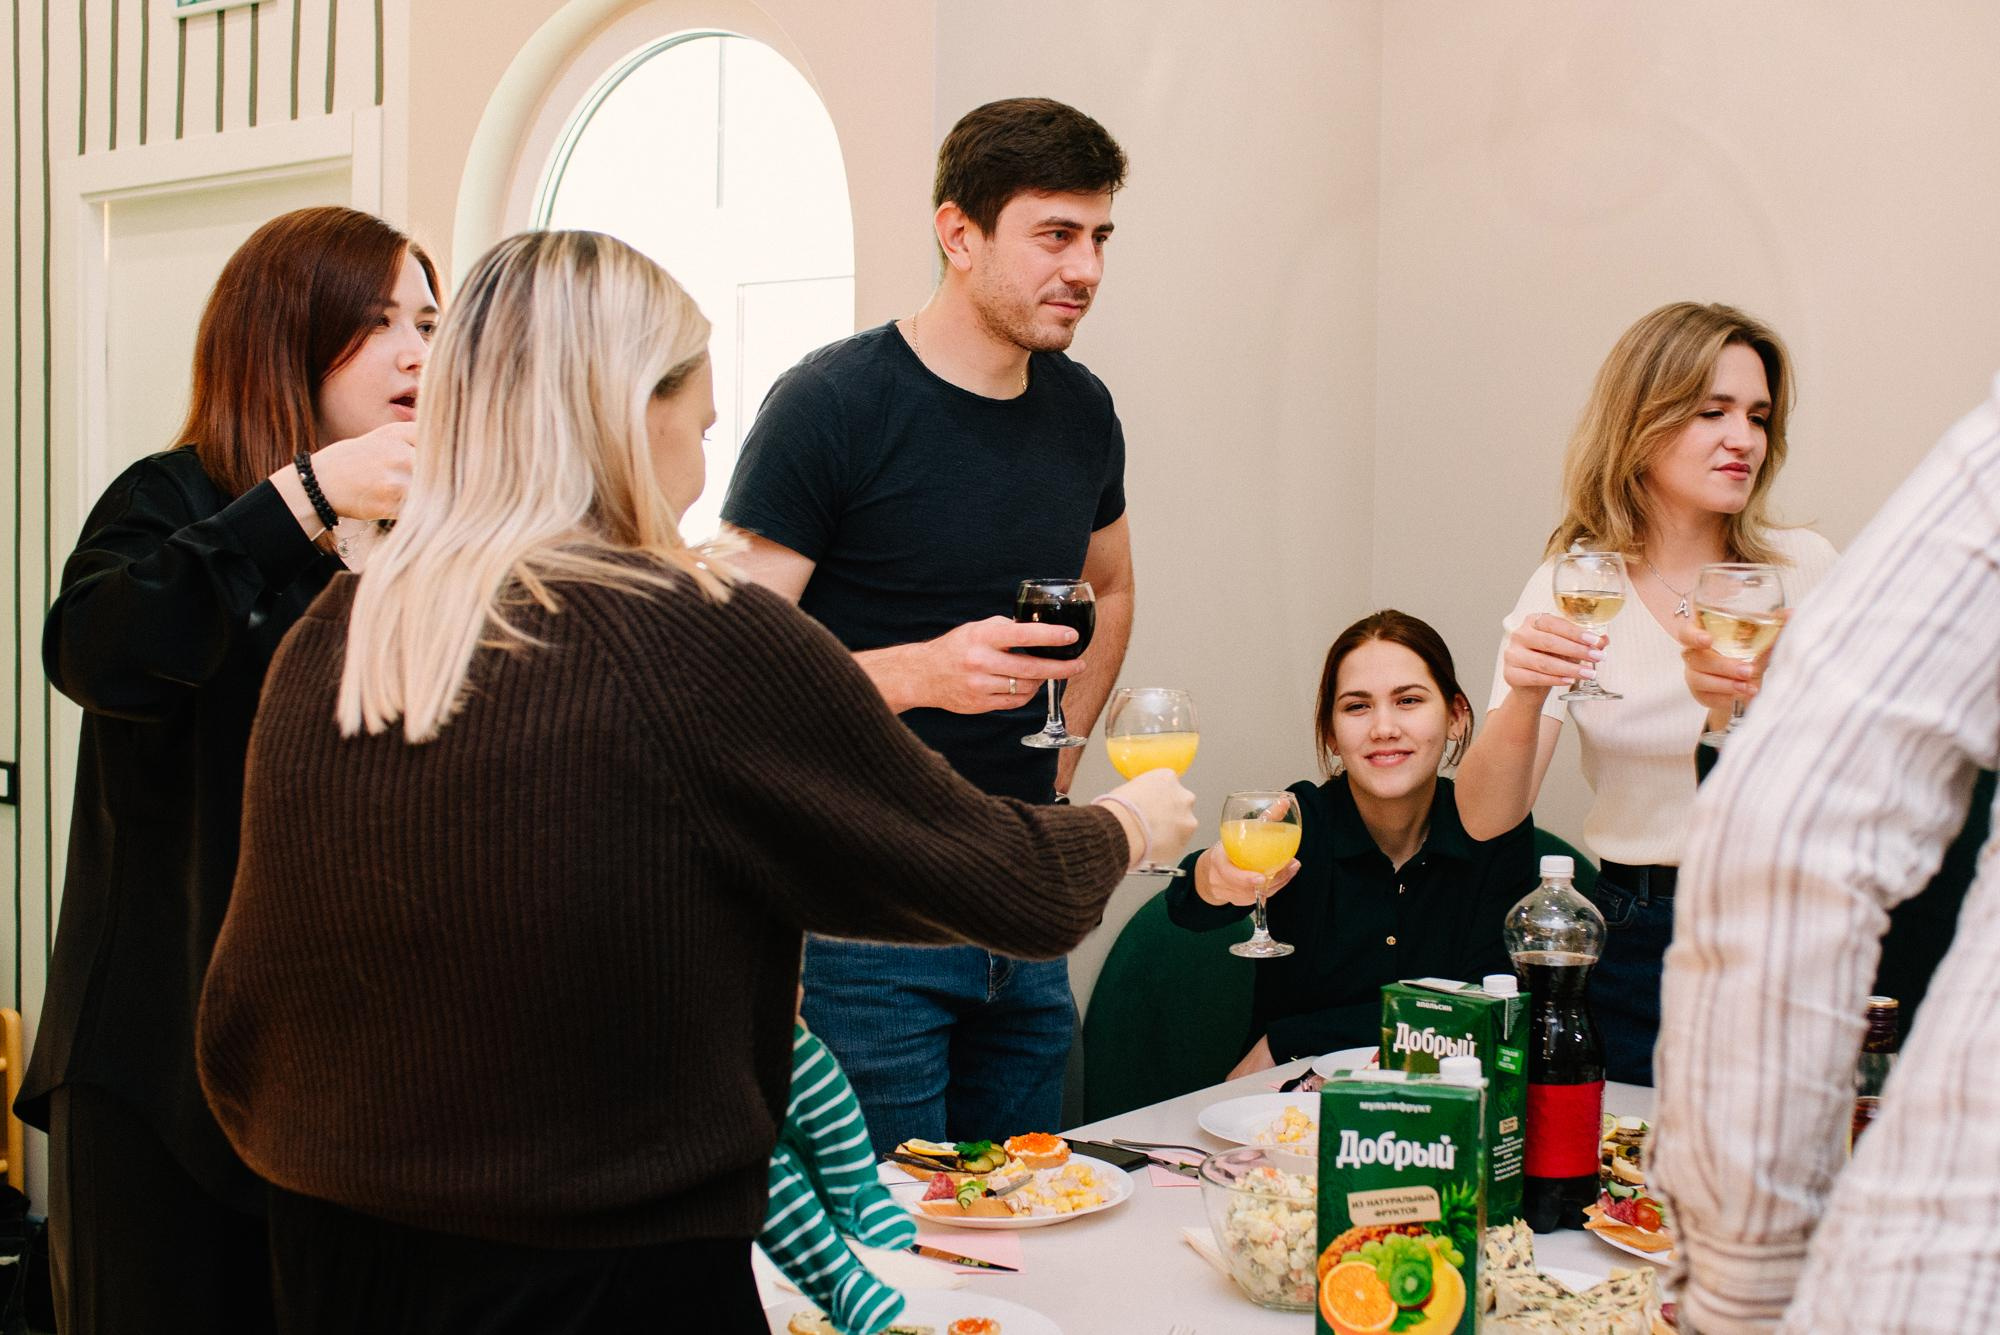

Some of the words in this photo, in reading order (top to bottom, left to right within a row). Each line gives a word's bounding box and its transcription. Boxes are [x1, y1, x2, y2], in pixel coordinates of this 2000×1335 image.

[1393, 1022, 1475, 1060] Добрый
[1359, 1101, 1432, 1113] мультифрукт
[1336, 1129, 1455, 1171] Добрый
[1374, 1207, 1419, 1217] ФРУКТОВ
